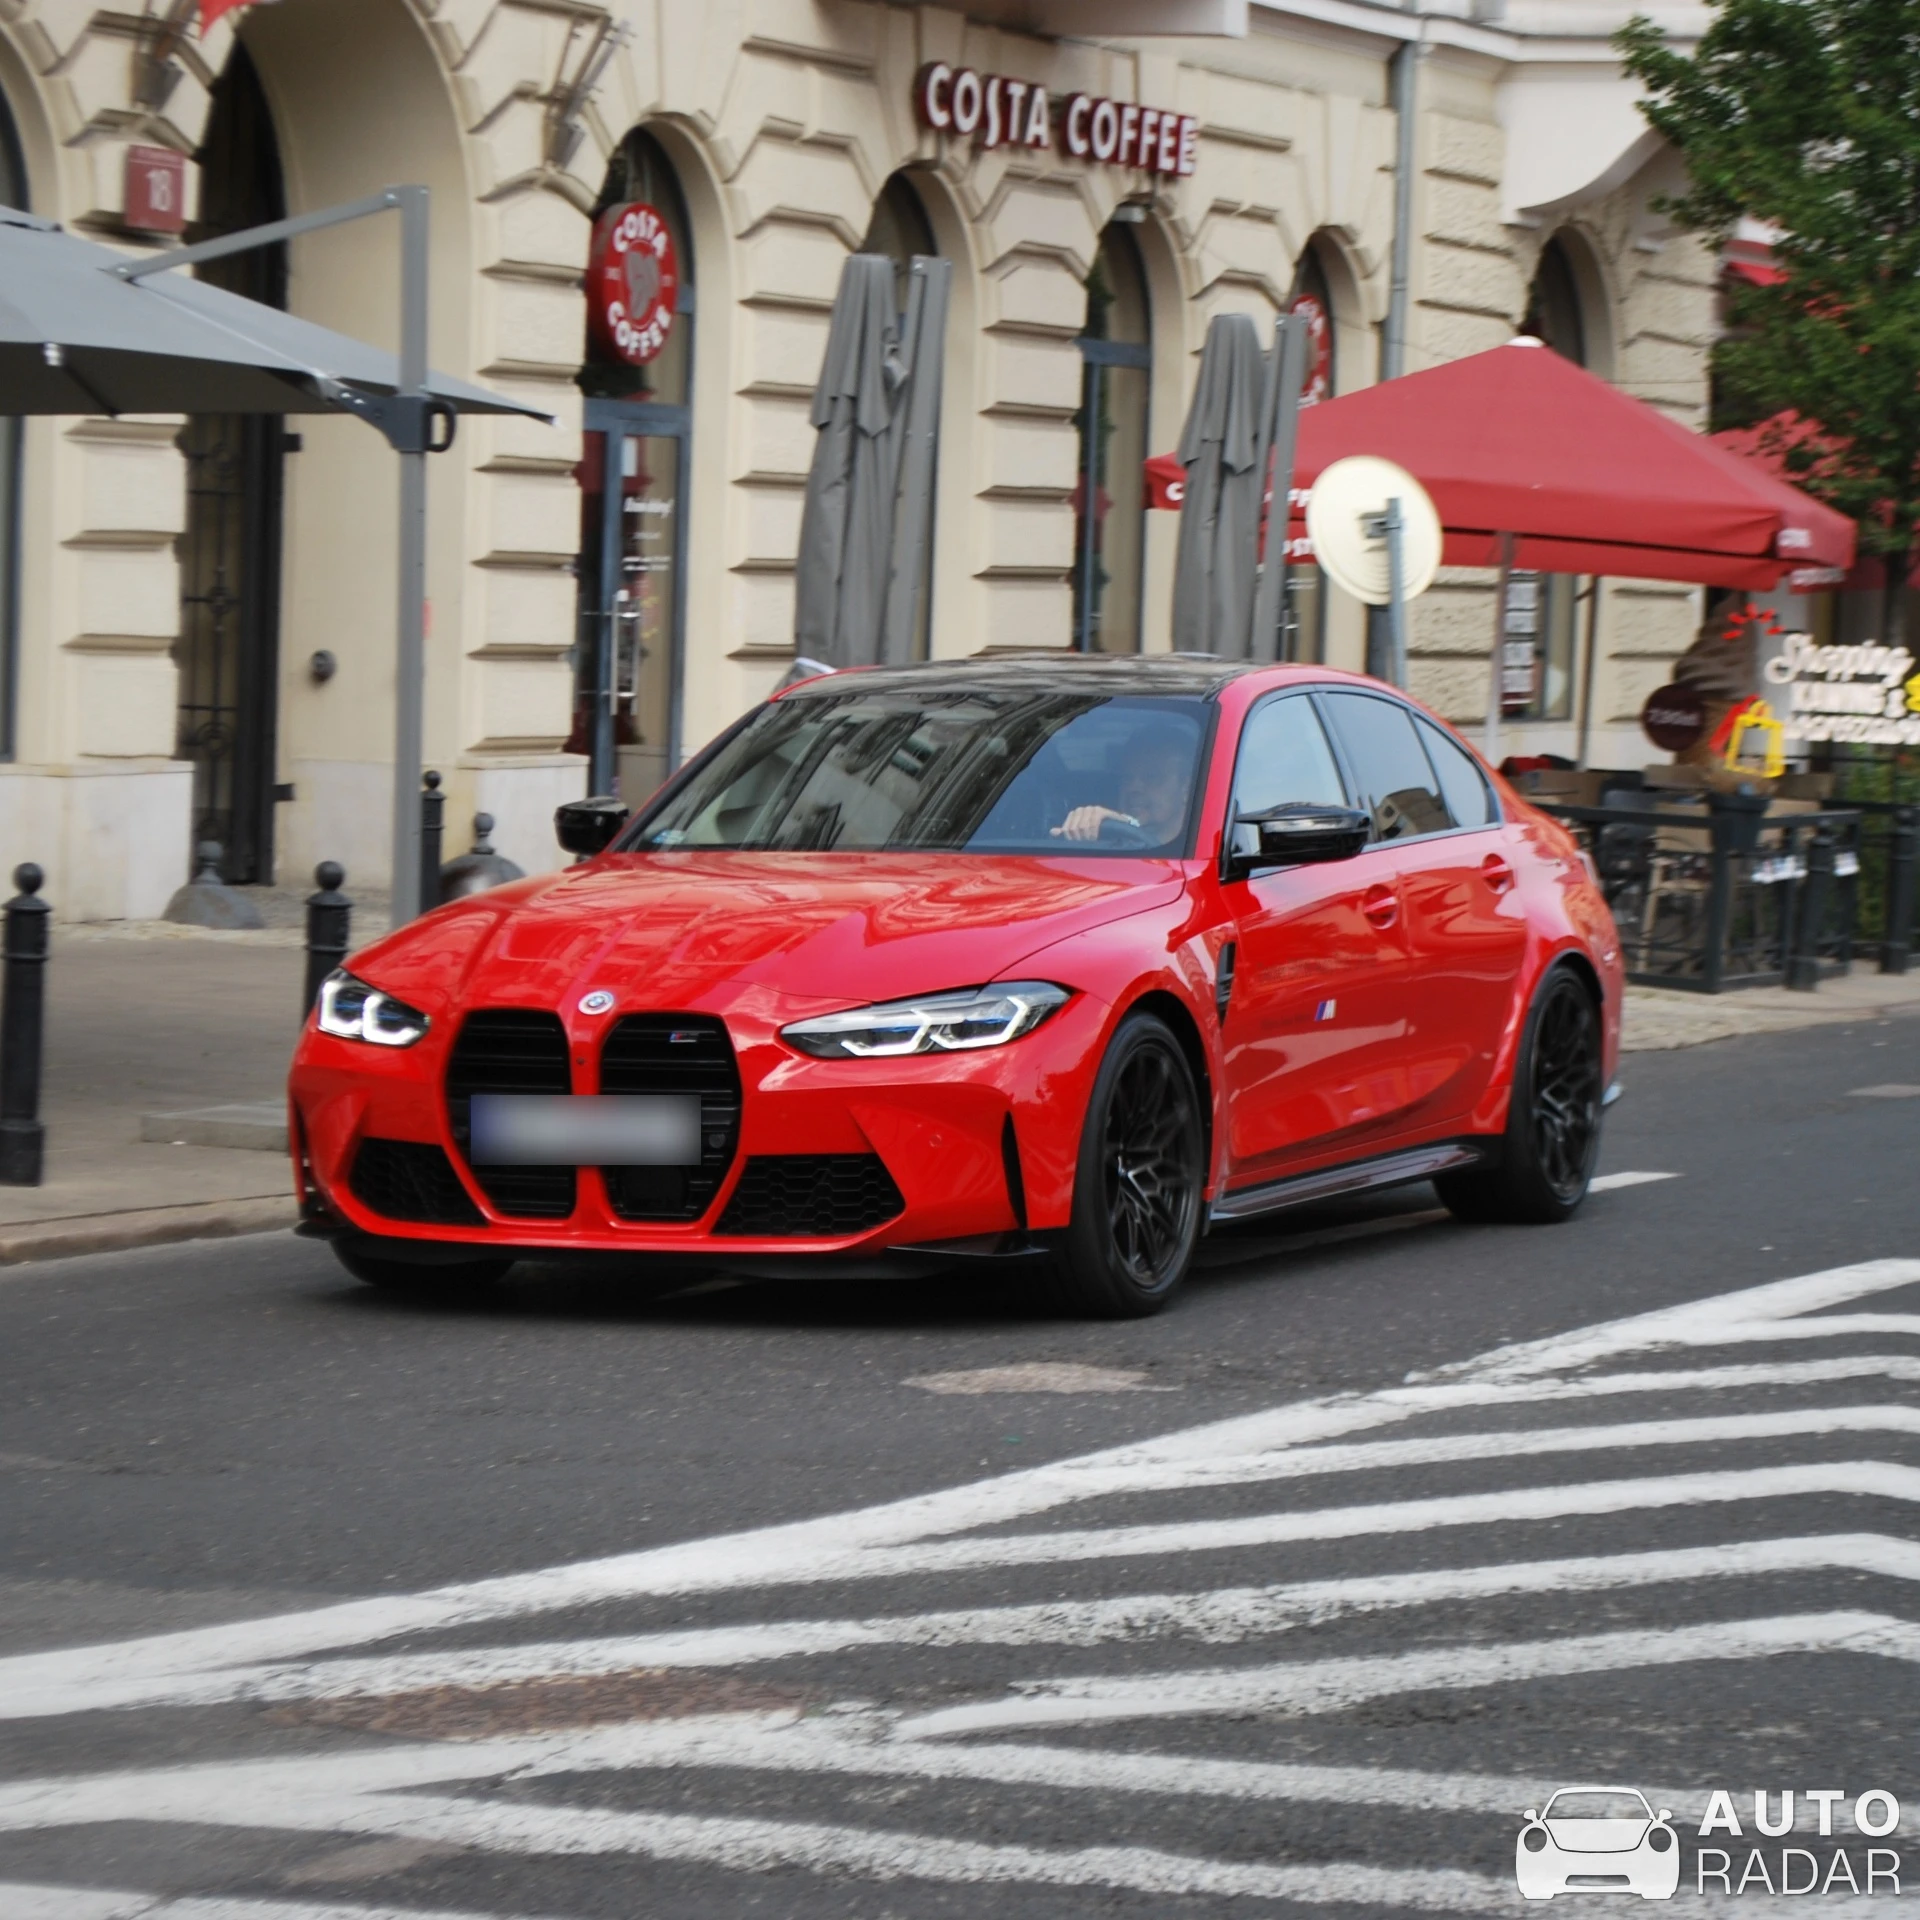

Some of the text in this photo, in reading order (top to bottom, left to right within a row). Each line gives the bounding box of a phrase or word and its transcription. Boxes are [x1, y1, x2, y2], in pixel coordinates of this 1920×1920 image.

[925, 63, 1198, 174] COSTA COFFEE
[145, 169, 173, 212] 18
[613, 210, 668, 259] COSTA
[607, 301, 671, 358] COFFEE
[1764, 633, 1916, 689] Shopping
